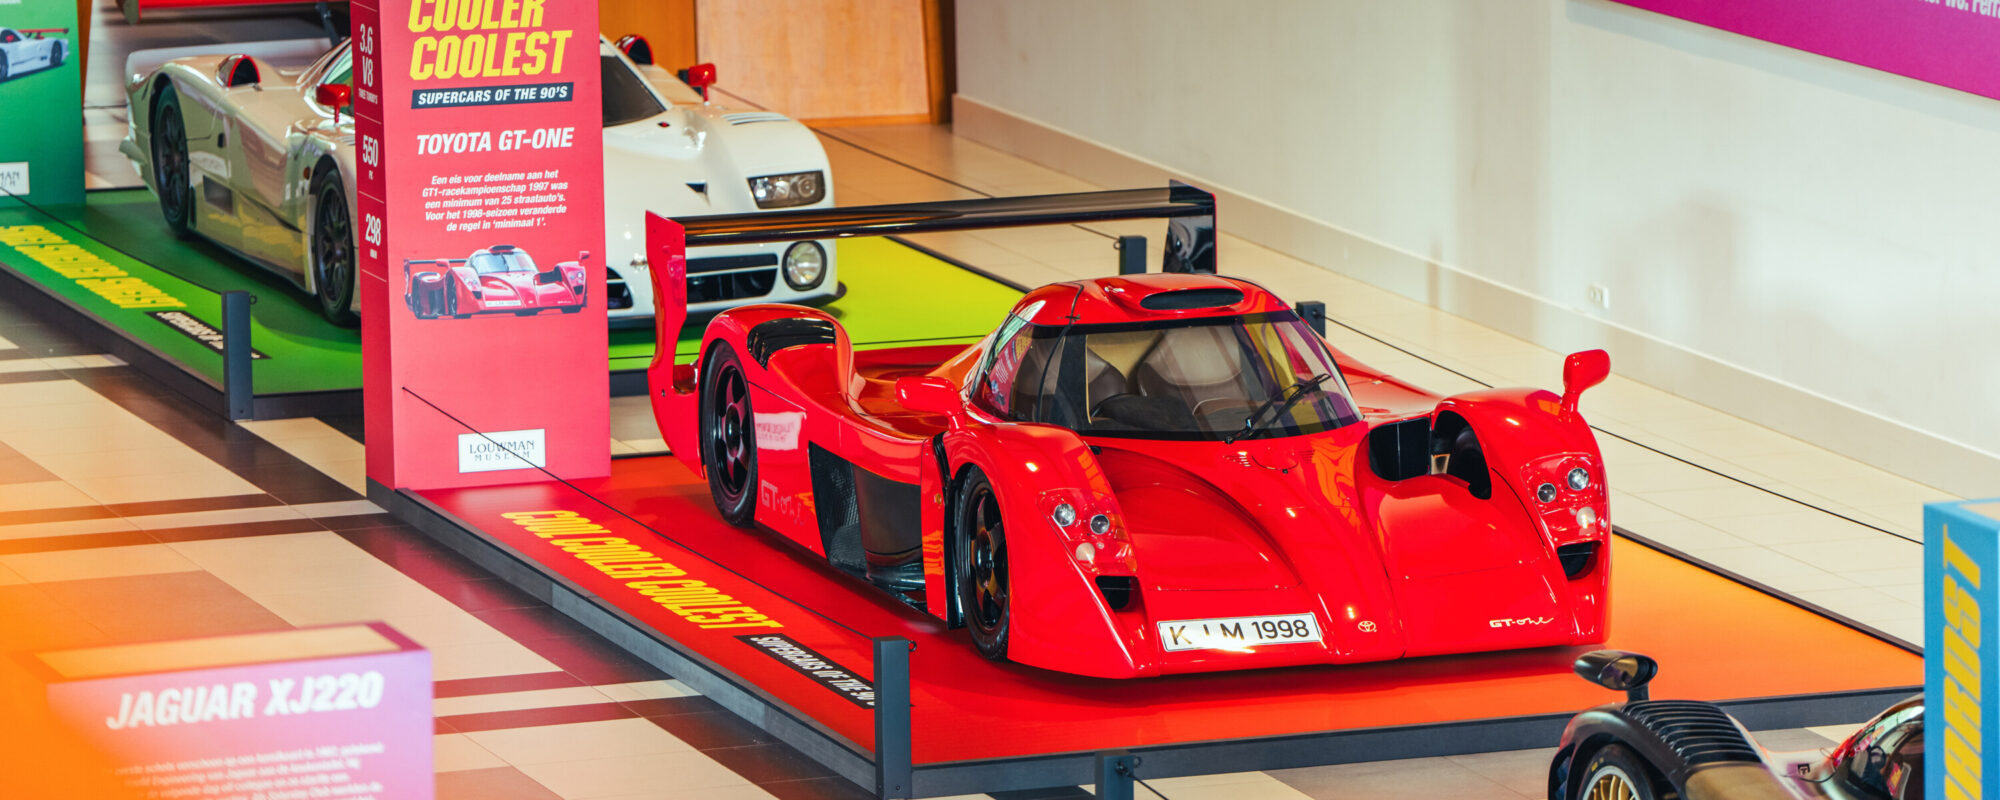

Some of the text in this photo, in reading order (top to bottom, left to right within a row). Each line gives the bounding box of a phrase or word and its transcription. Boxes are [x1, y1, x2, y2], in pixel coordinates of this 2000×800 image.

[408, 0, 544, 33] COOLER
[360, 24, 373, 55] 3.6
[409, 30, 573, 81] COOLEST
[362, 56, 374, 87] V8
[418, 86, 568, 105] SUPERCARS OF THE 90'S
[362, 135, 379, 167] 550
[416, 127, 575, 155] TOYOTA GT-ONE
[422, 182, 568, 198] GT1-racekampioenschap 1997 was
[431, 169, 559, 185] Een eis voor deelname aan het
[425, 200, 441, 209] een
[442, 198, 482, 208] minimum
[484, 198, 500, 206] van
[501, 195, 512, 205] 25
[425, 205, 567, 221] Voor het 1998-seizoen veranderde
[365, 213, 381, 247] 298
[446, 222, 457, 232] de
[459, 220, 481, 232] regel
[482, 219, 491, 229] in
[469, 440, 535, 454] LOUWMAN
[501, 510, 784, 629] COOL COOLER COOLEST
[1169, 625, 1192, 645] K
[1251, 619, 1310, 639] 1998
[750, 636, 834, 670] SUPERCARS
[812, 670, 850, 679] OF
[828, 678, 873, 691] THE
[106, 671, 385, 730] JAGUAR XJ220
